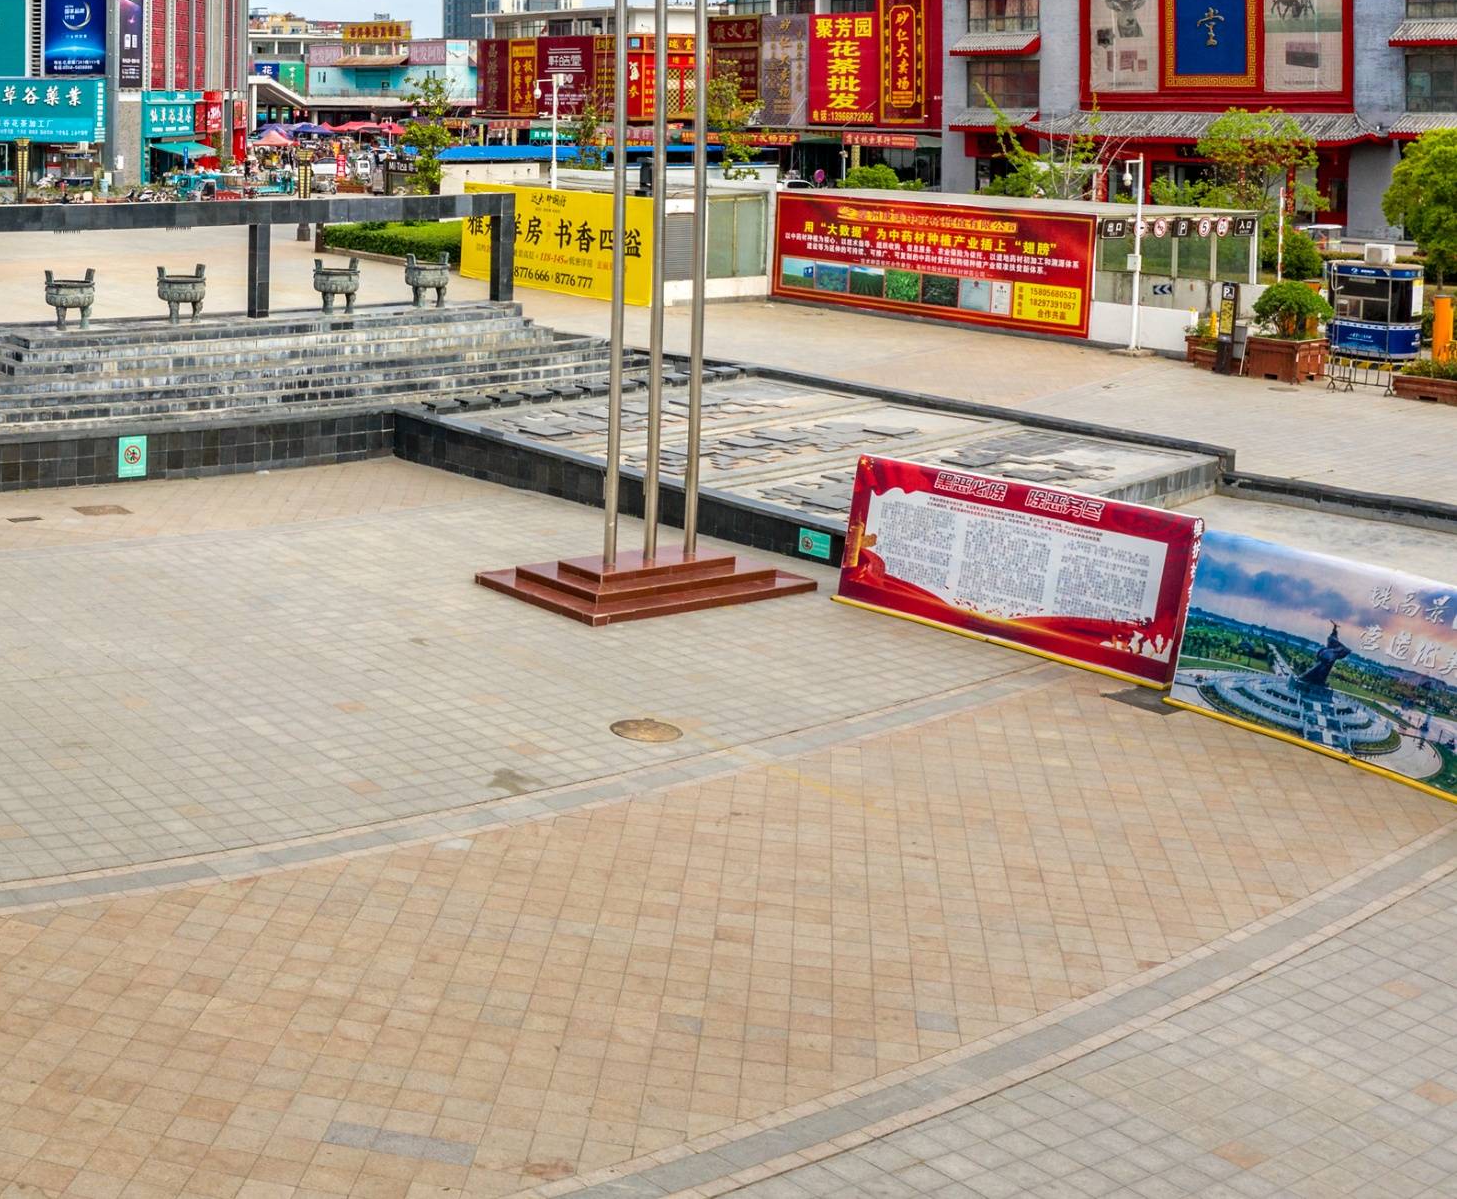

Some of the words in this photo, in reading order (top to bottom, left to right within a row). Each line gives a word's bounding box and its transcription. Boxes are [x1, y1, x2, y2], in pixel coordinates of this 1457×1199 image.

[815, 17, 873, 39] 聚芳园
[262, 65, 273, 75] 花
[826, 40, 862, 110] 花茶批发
[1201, 221, 1208, 234] 5
[1239, 220, 1253, 229] 入口
[934, 471, 1008, 502] 黑恶必除
[1024, 489, 1106, 522] 除恶务尽
